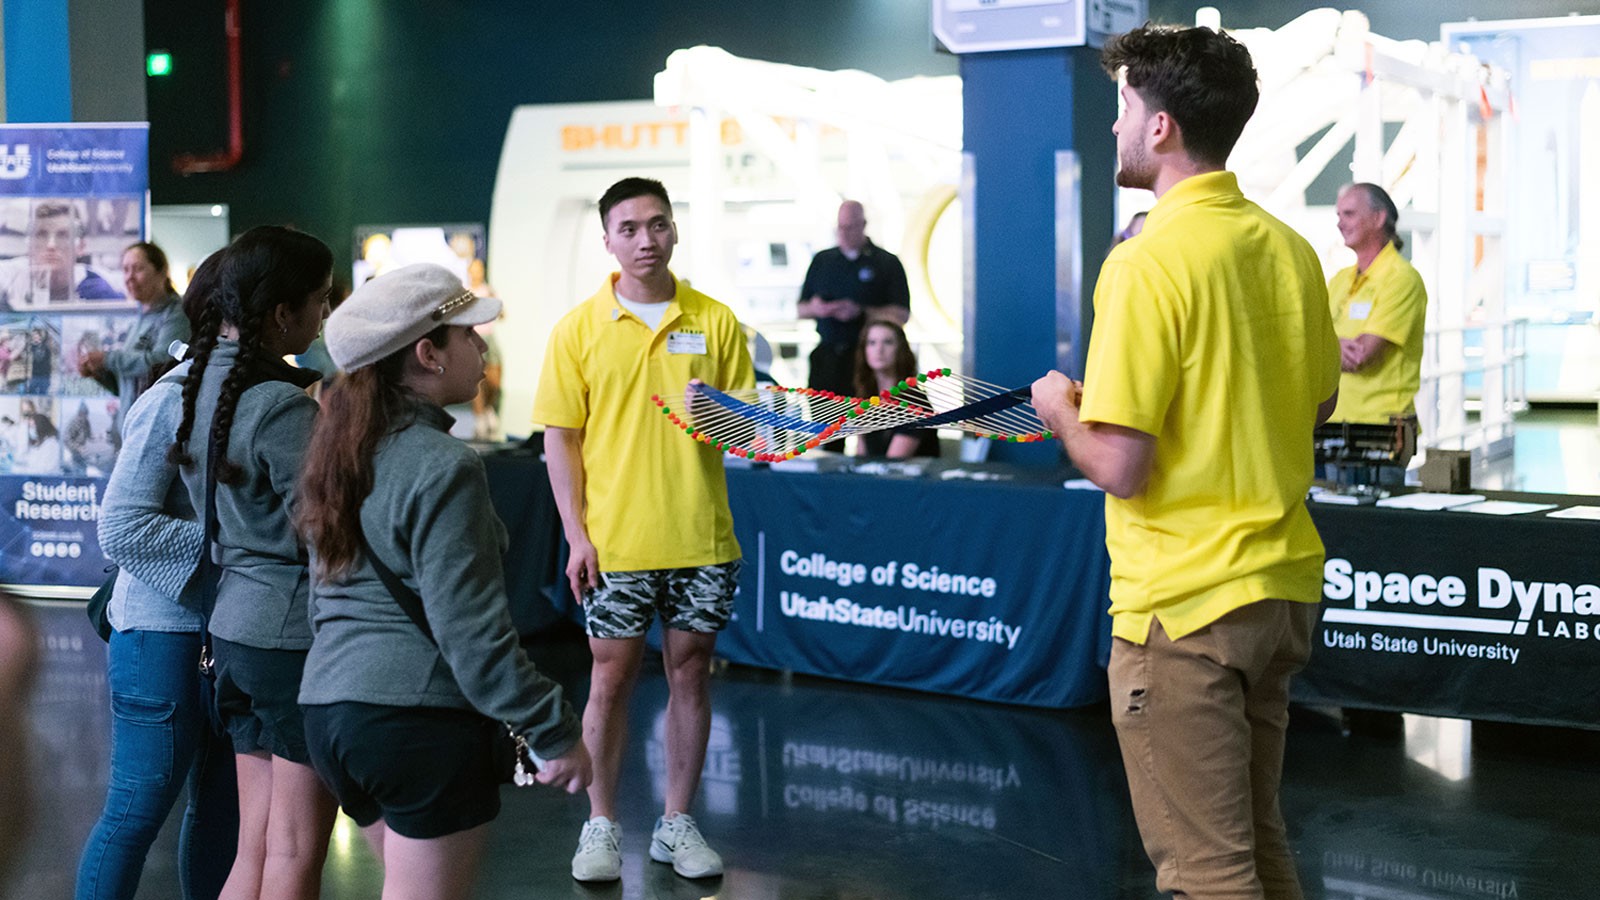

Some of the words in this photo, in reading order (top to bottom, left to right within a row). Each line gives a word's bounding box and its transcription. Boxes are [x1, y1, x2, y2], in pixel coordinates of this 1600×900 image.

[15, 500, 102, 521] Research
[22, 481, 97, 502] Student
[780, 550, 866, 587] College
[871, 561, 897, 587] of
[901, 563, 997, 598] Science
[1323, 558, 1466, 609] Space
[1478, 567, 1600, 621] Dyna
[780, 591, 1022, 650] UtahStateUniversity
[1323, 629, 1366, 650] Utah
[1371, 632, 1418, 655] State
[1423, 637, 1520, 665] University
